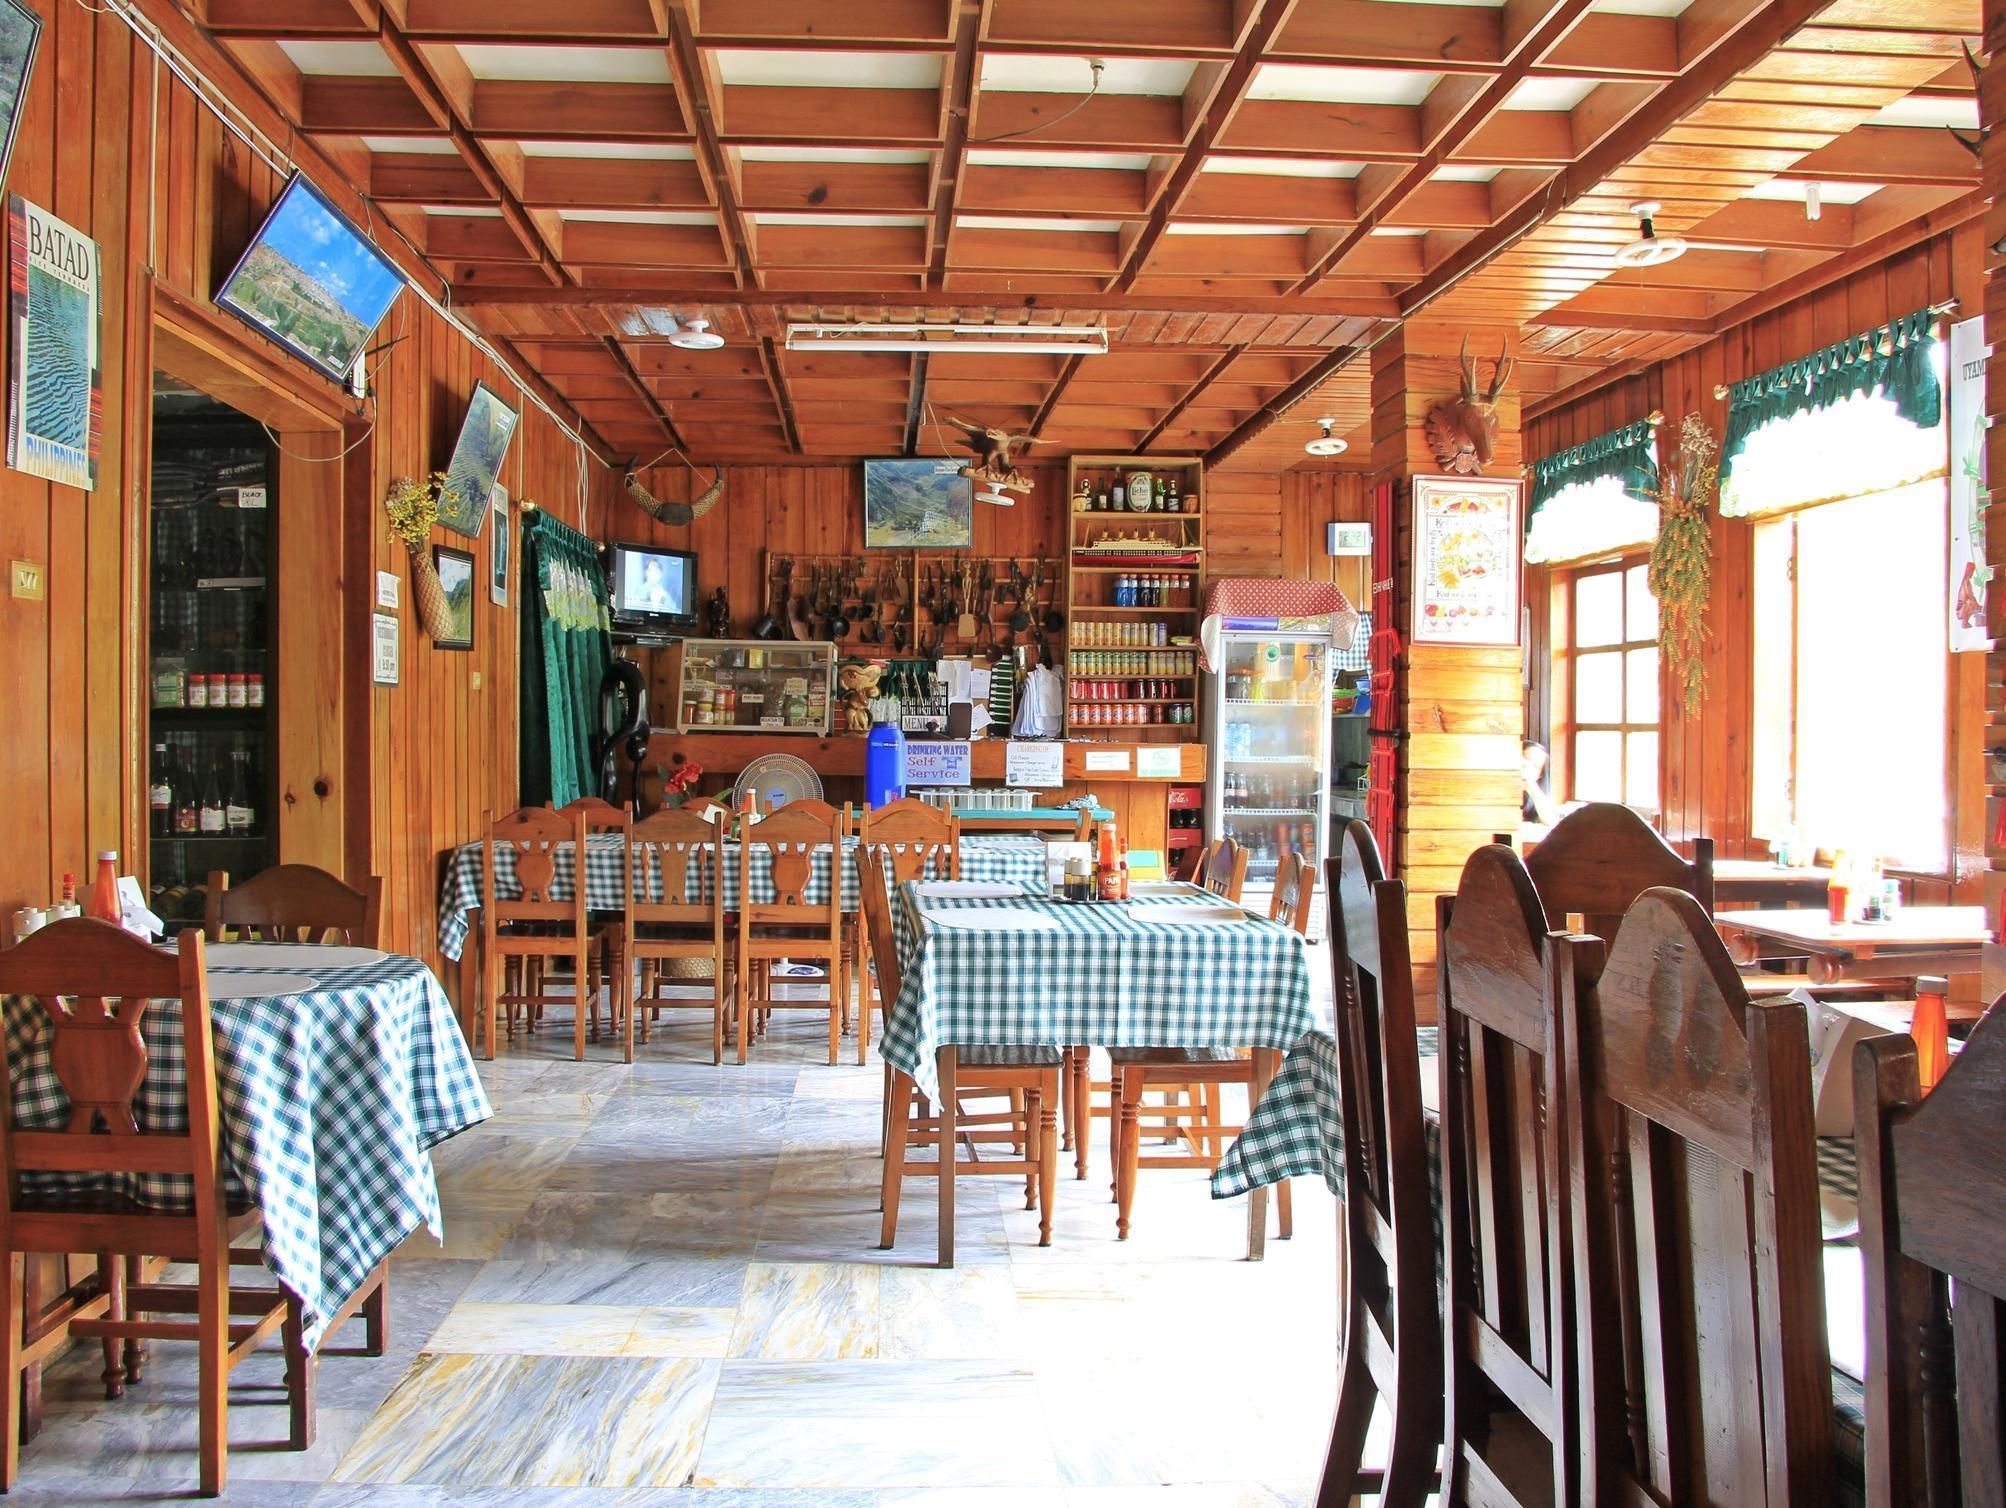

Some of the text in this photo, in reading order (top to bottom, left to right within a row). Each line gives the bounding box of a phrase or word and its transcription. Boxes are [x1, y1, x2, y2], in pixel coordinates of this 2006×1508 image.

[28, 214, 89, 281] BATAD
[26, 436, 86, 487] PHILIPPINES
[903, 716, 929, 730] MENU
[907, 744, 968, 755] DRINKING WATER
[907, 756, 937, 766] Self
[907, 769, 960, 778] Service
